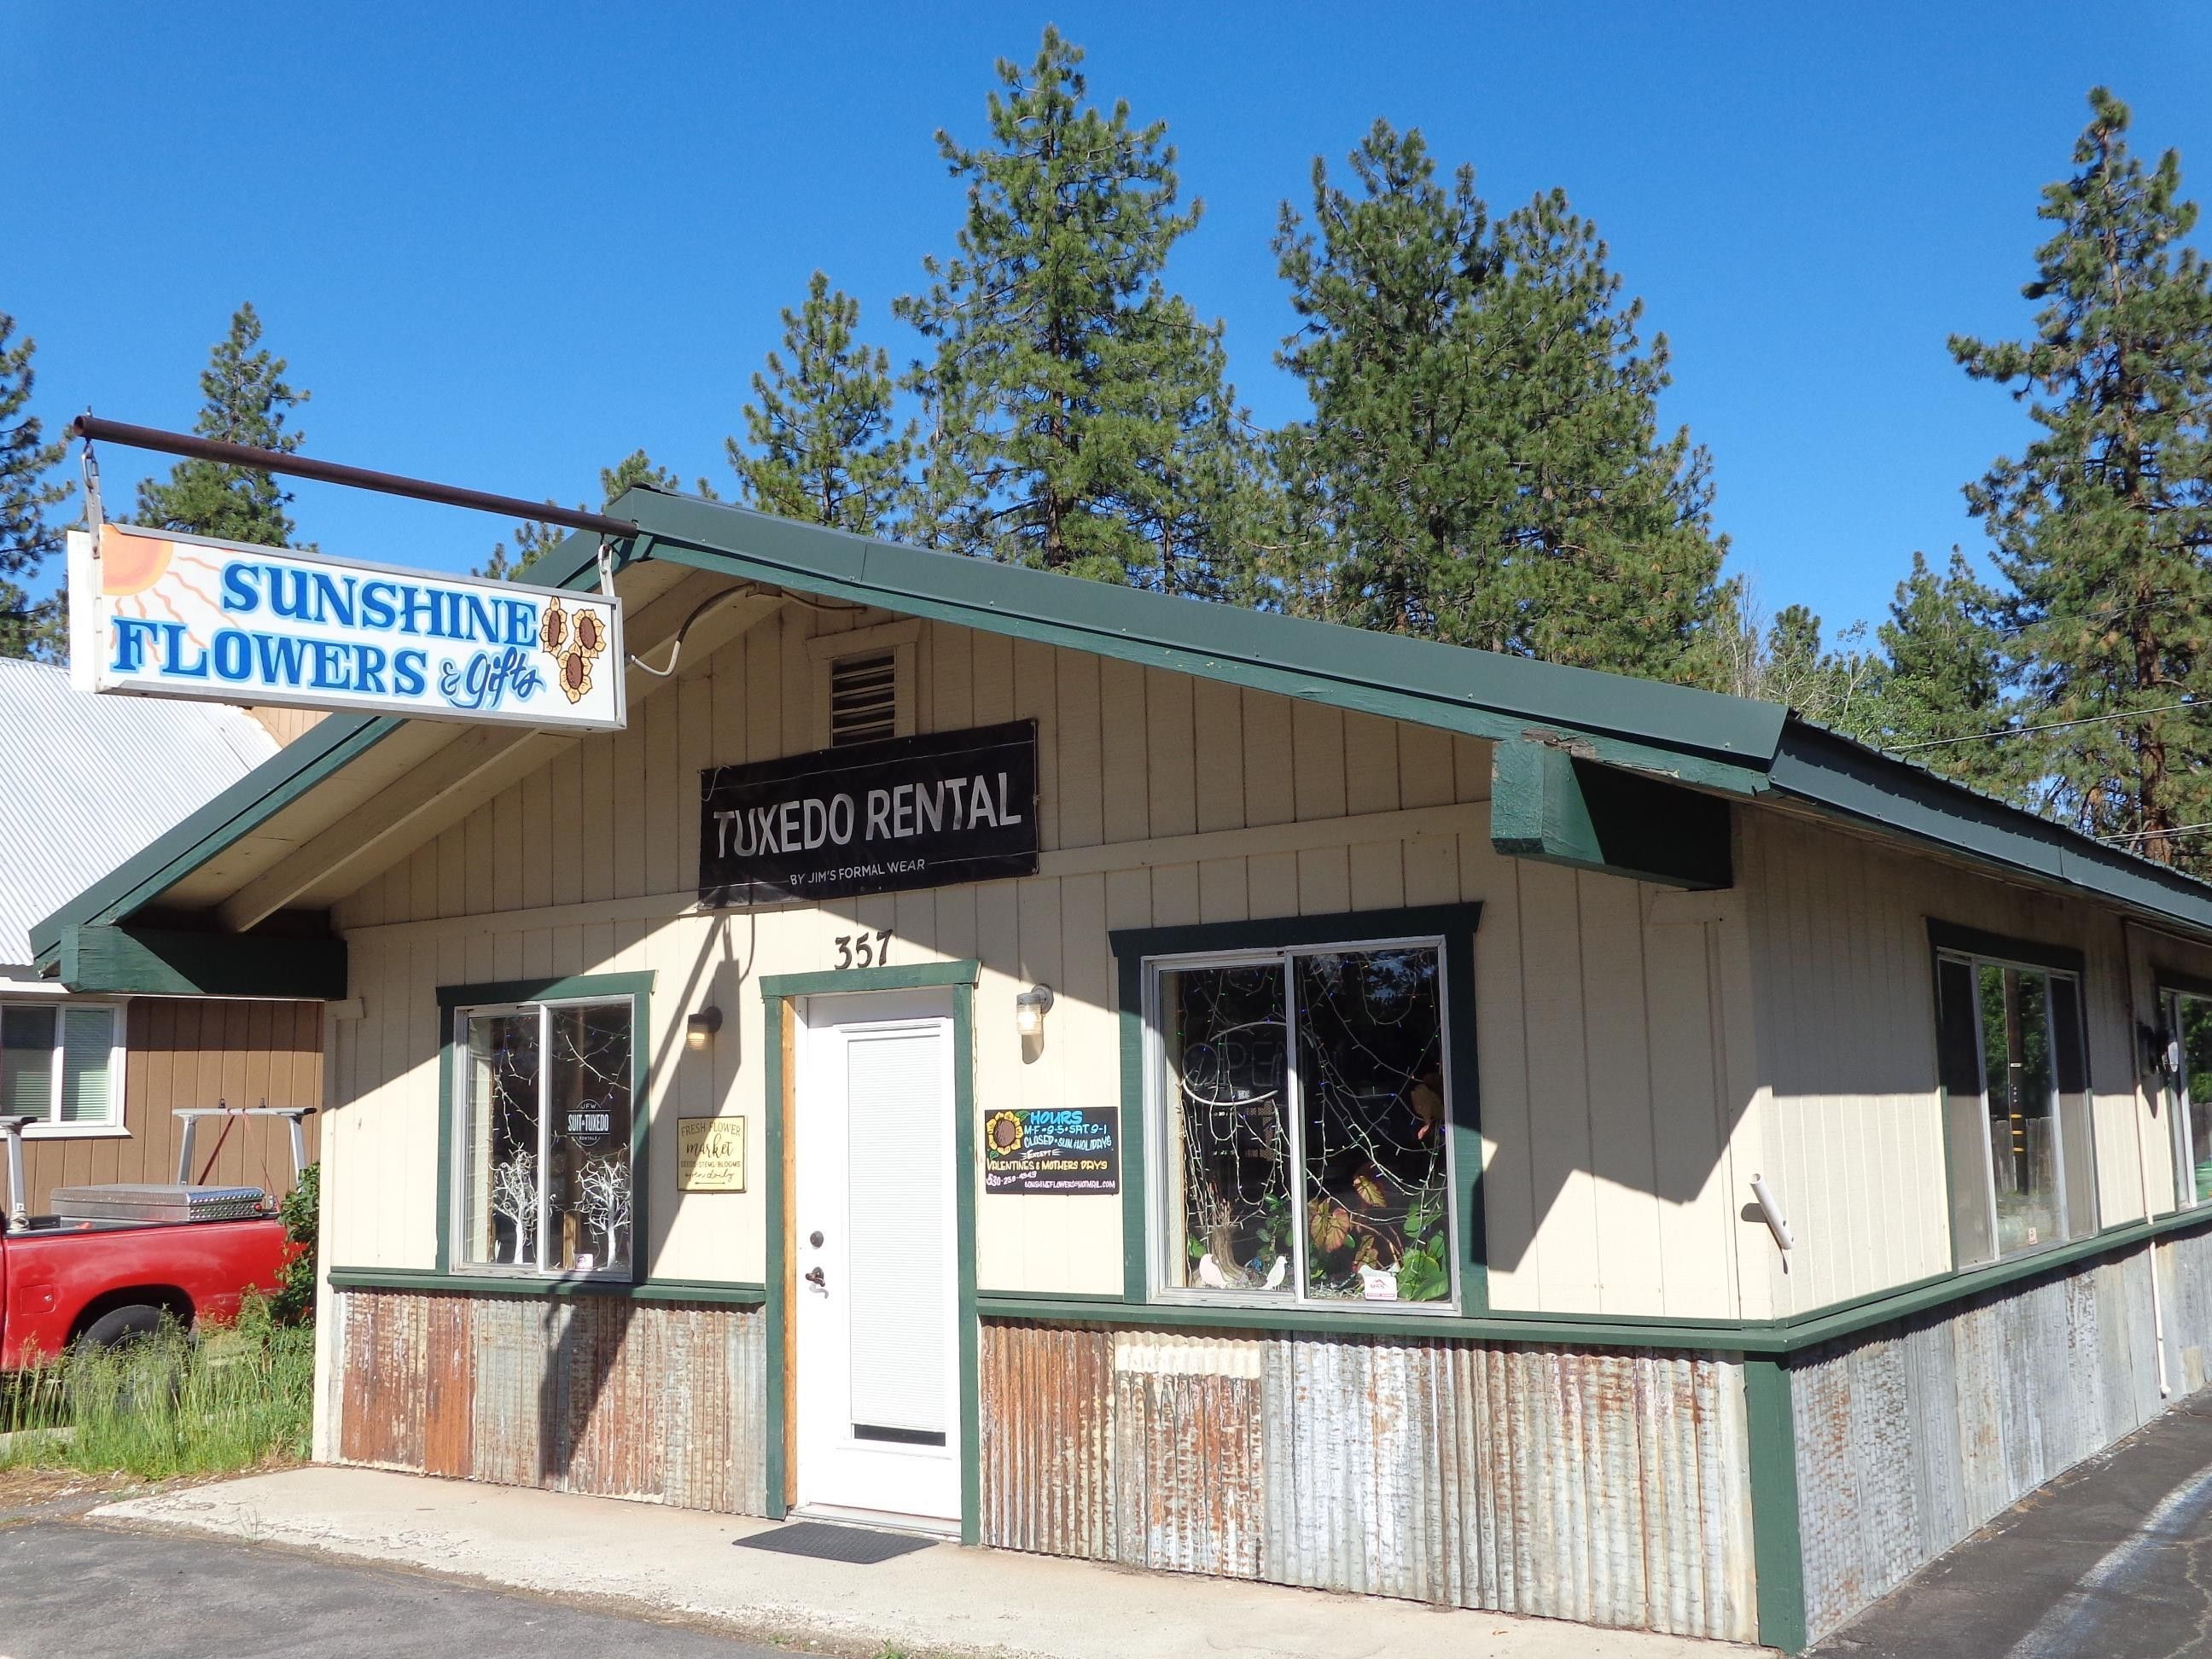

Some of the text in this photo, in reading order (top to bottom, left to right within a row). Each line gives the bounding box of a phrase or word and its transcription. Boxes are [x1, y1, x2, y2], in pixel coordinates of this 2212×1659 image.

[222, 562, 537, 648] SUNSHINE
[111, 617, 427, 696] FLOWERS
[440, 661, 461, 696] &
[713, 771, 1022, 859] TUXEDO RENTAL
[789, 858, 926, 886] BY JIM'S FORMAL WEAR
[834, 928, 894, 970] 357
[568, 1114, 583, 1132] SUIT
[585, 1114, 609, 1132] TUXEDO
[681, 1121, 741, 1138] FRESH FLOWER
[1030, 1110, 1083, 1125] HOURS
[686, 1132, 734, 1159] market
[1024, 1134, 1055, 1149] CLOSED
[1076, 1135, 1112, 1151] HOLIDAYS
[987, 1158, 1035, 1171] VALENTINES
[1041, 1160, 1079, 1171] MOTHERS
[1080, 1160, 1108, 1170] DAYS
